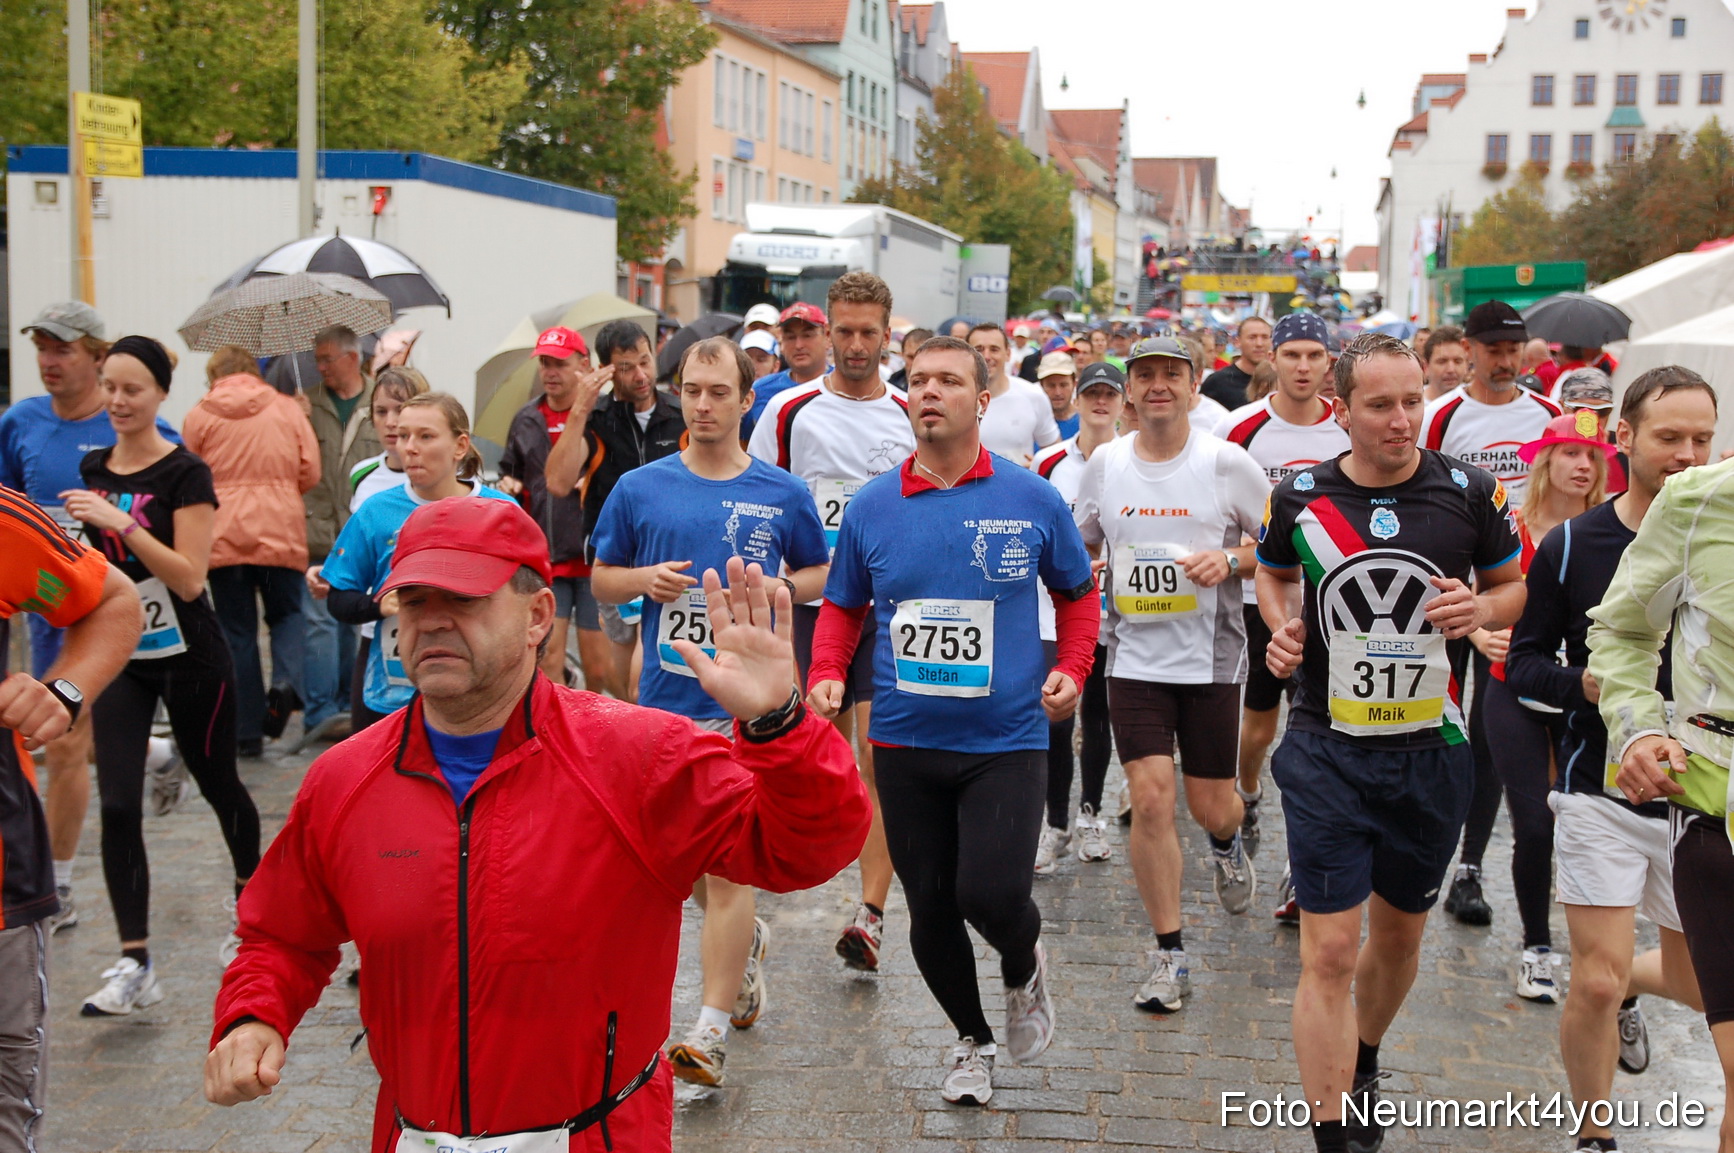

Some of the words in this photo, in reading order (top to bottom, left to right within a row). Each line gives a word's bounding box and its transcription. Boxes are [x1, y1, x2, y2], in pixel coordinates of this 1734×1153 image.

[721, 500, 734, 508] 12.
[735, 501, 784, 516] NEUMARKTER
[732, 507, 774, 519] STADTLAUF
[1139, 508, 1193, 517] KLEBL
[963, 520, 978, 529] 12.
[978, 520, 1033, 530] NEUMARKTER
[977, 526, 1023, 535] STADTLAUF
[1134, 547, 1168, 558] BOCK
[1128, 564, 1178, 594] 409
[920, 604, 960, 616] BOCK
[1135, 598, 1172, 613] Günter
[668, 610, 715, 645] 25
[900, 623, 982, 662] 2753
[1366, 640, 1417, 652] BOCK
[917, 666, 958, 683] Stefan
[1352, 660, 1428, 700] 317
[1367, 705, 1406, 723] Maik
